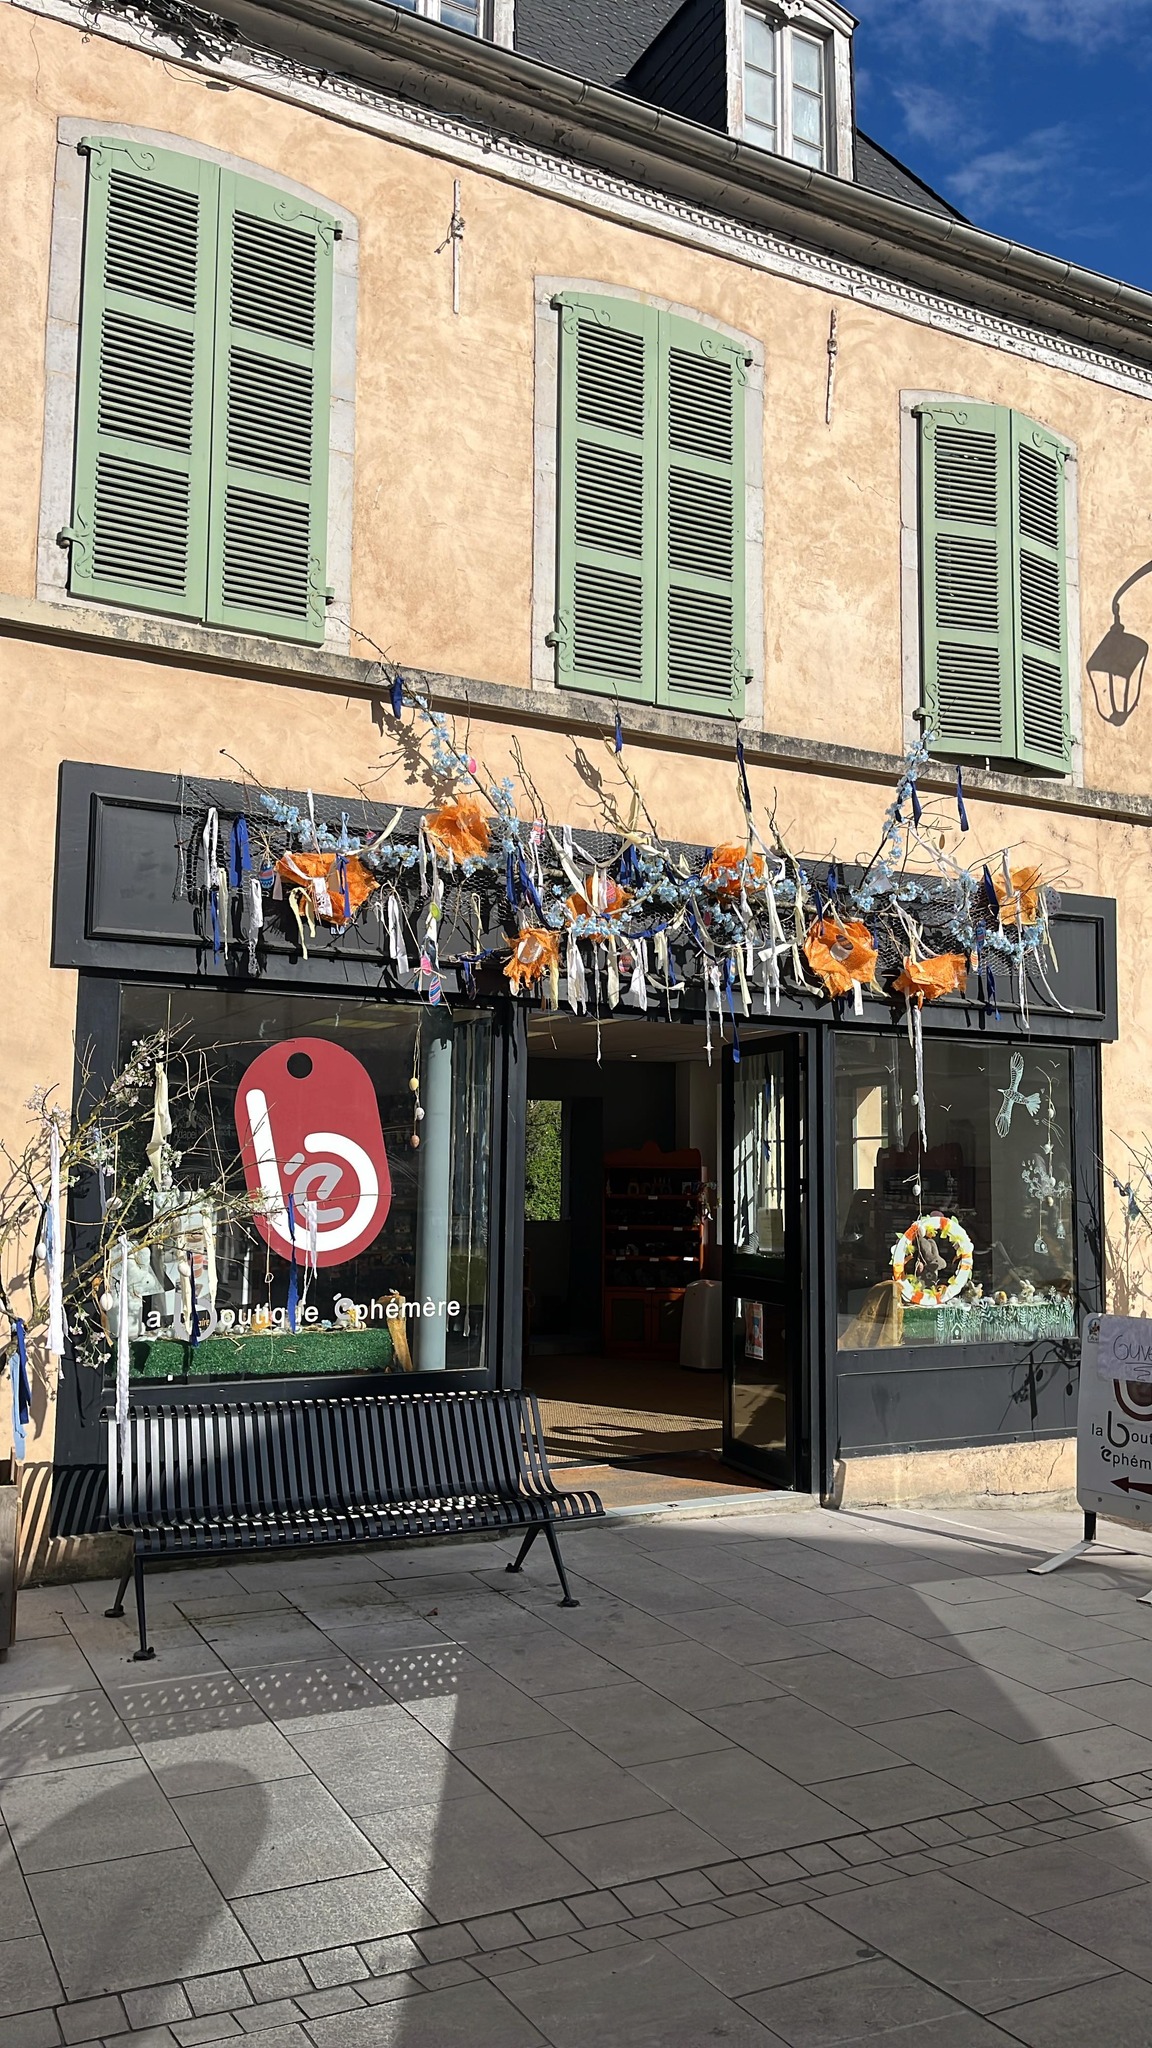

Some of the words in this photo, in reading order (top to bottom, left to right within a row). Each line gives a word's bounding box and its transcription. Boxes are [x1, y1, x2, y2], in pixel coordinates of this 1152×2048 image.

[333, 1293, 461, 1328] éphémère
[1091, 1422, 1103, 1437] la
[1100, 1445, 1152, 1470] éphém
